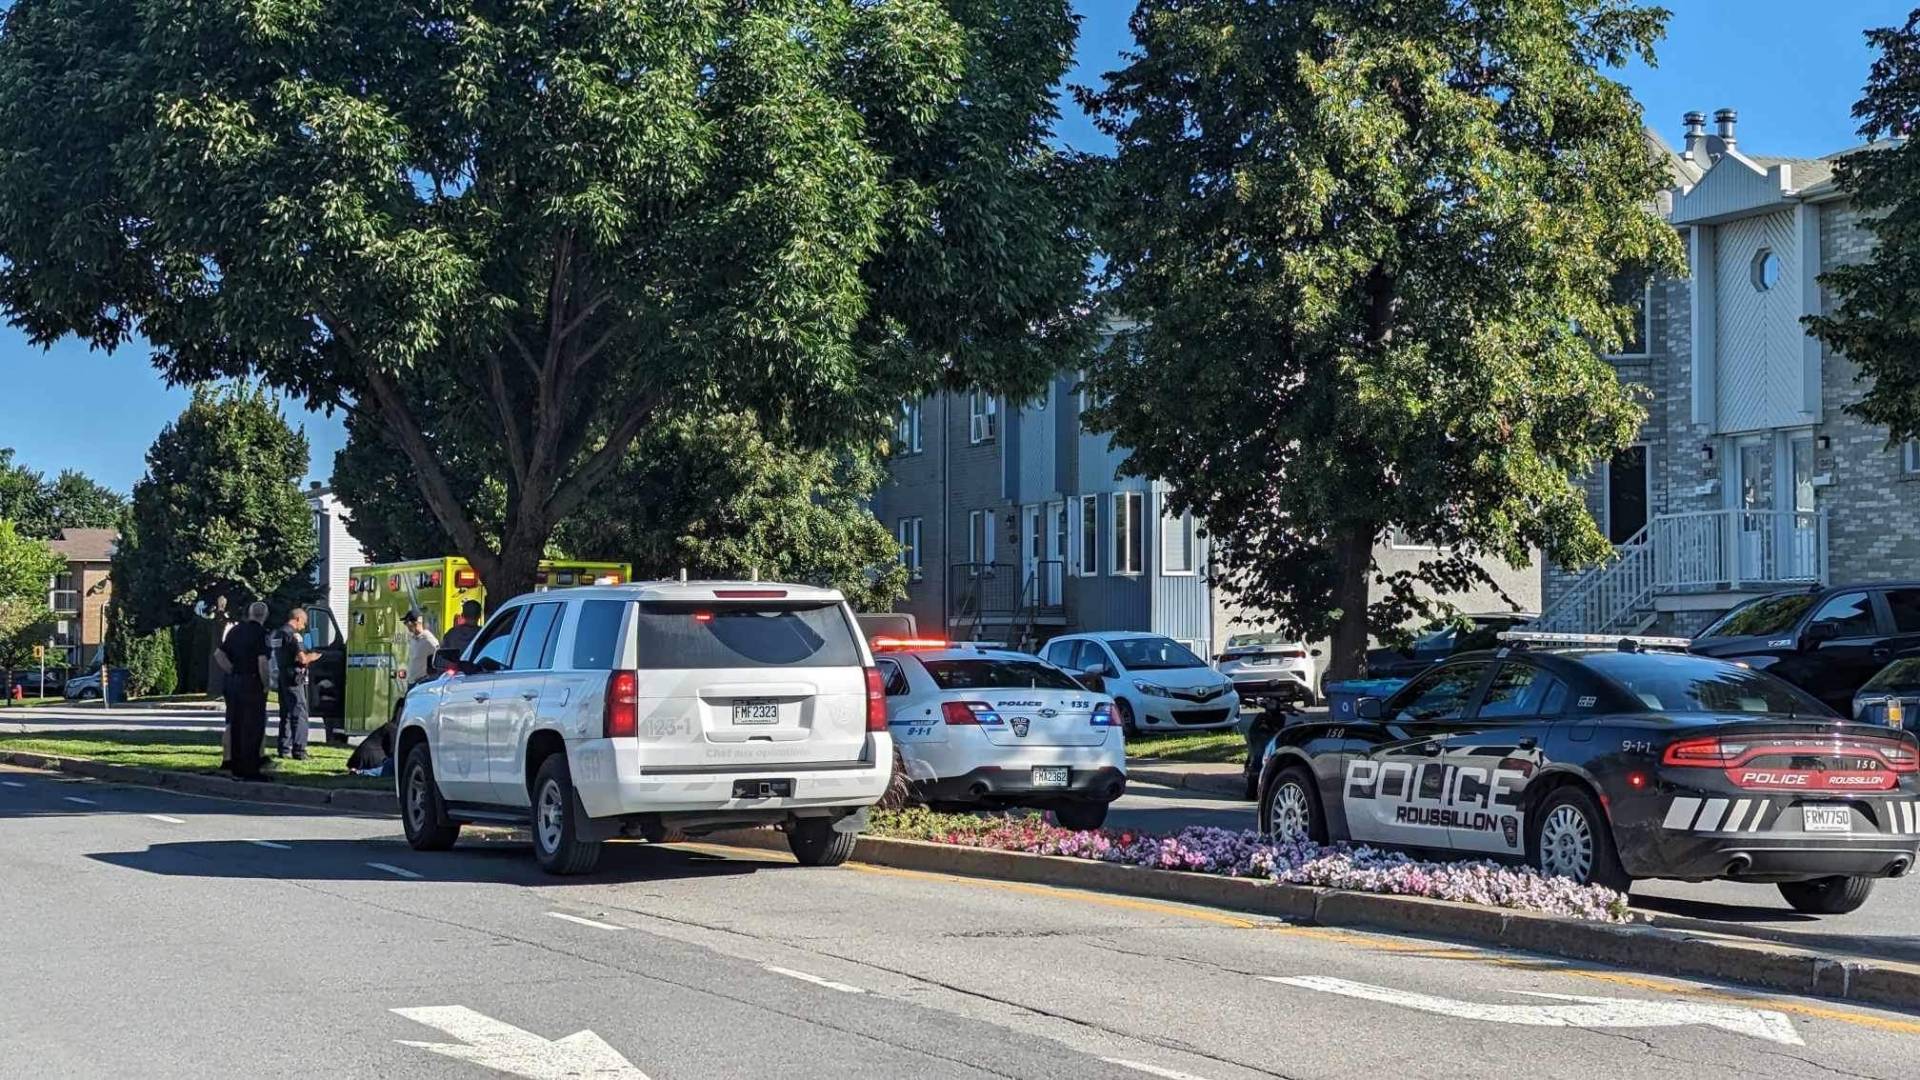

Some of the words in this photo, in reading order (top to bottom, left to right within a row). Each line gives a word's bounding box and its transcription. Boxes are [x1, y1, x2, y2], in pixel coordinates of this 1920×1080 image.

[735, 705, 777, 718] FMF2323
[1326, 728, 1346, 738] 150
[1621, 739, 1651, 752] 9-1-1
[1856, 759, 1877, 769] 150
[1343, 759, 1525, 809] POLICE
[1742, 772, 1809, 785] POLICE
[1828, 775, 1884, 785] ROUSSILLON
[1396, 806, 1499, 832] ROUSSILLON
[1805, 809, 1849, 824] FRM7750
